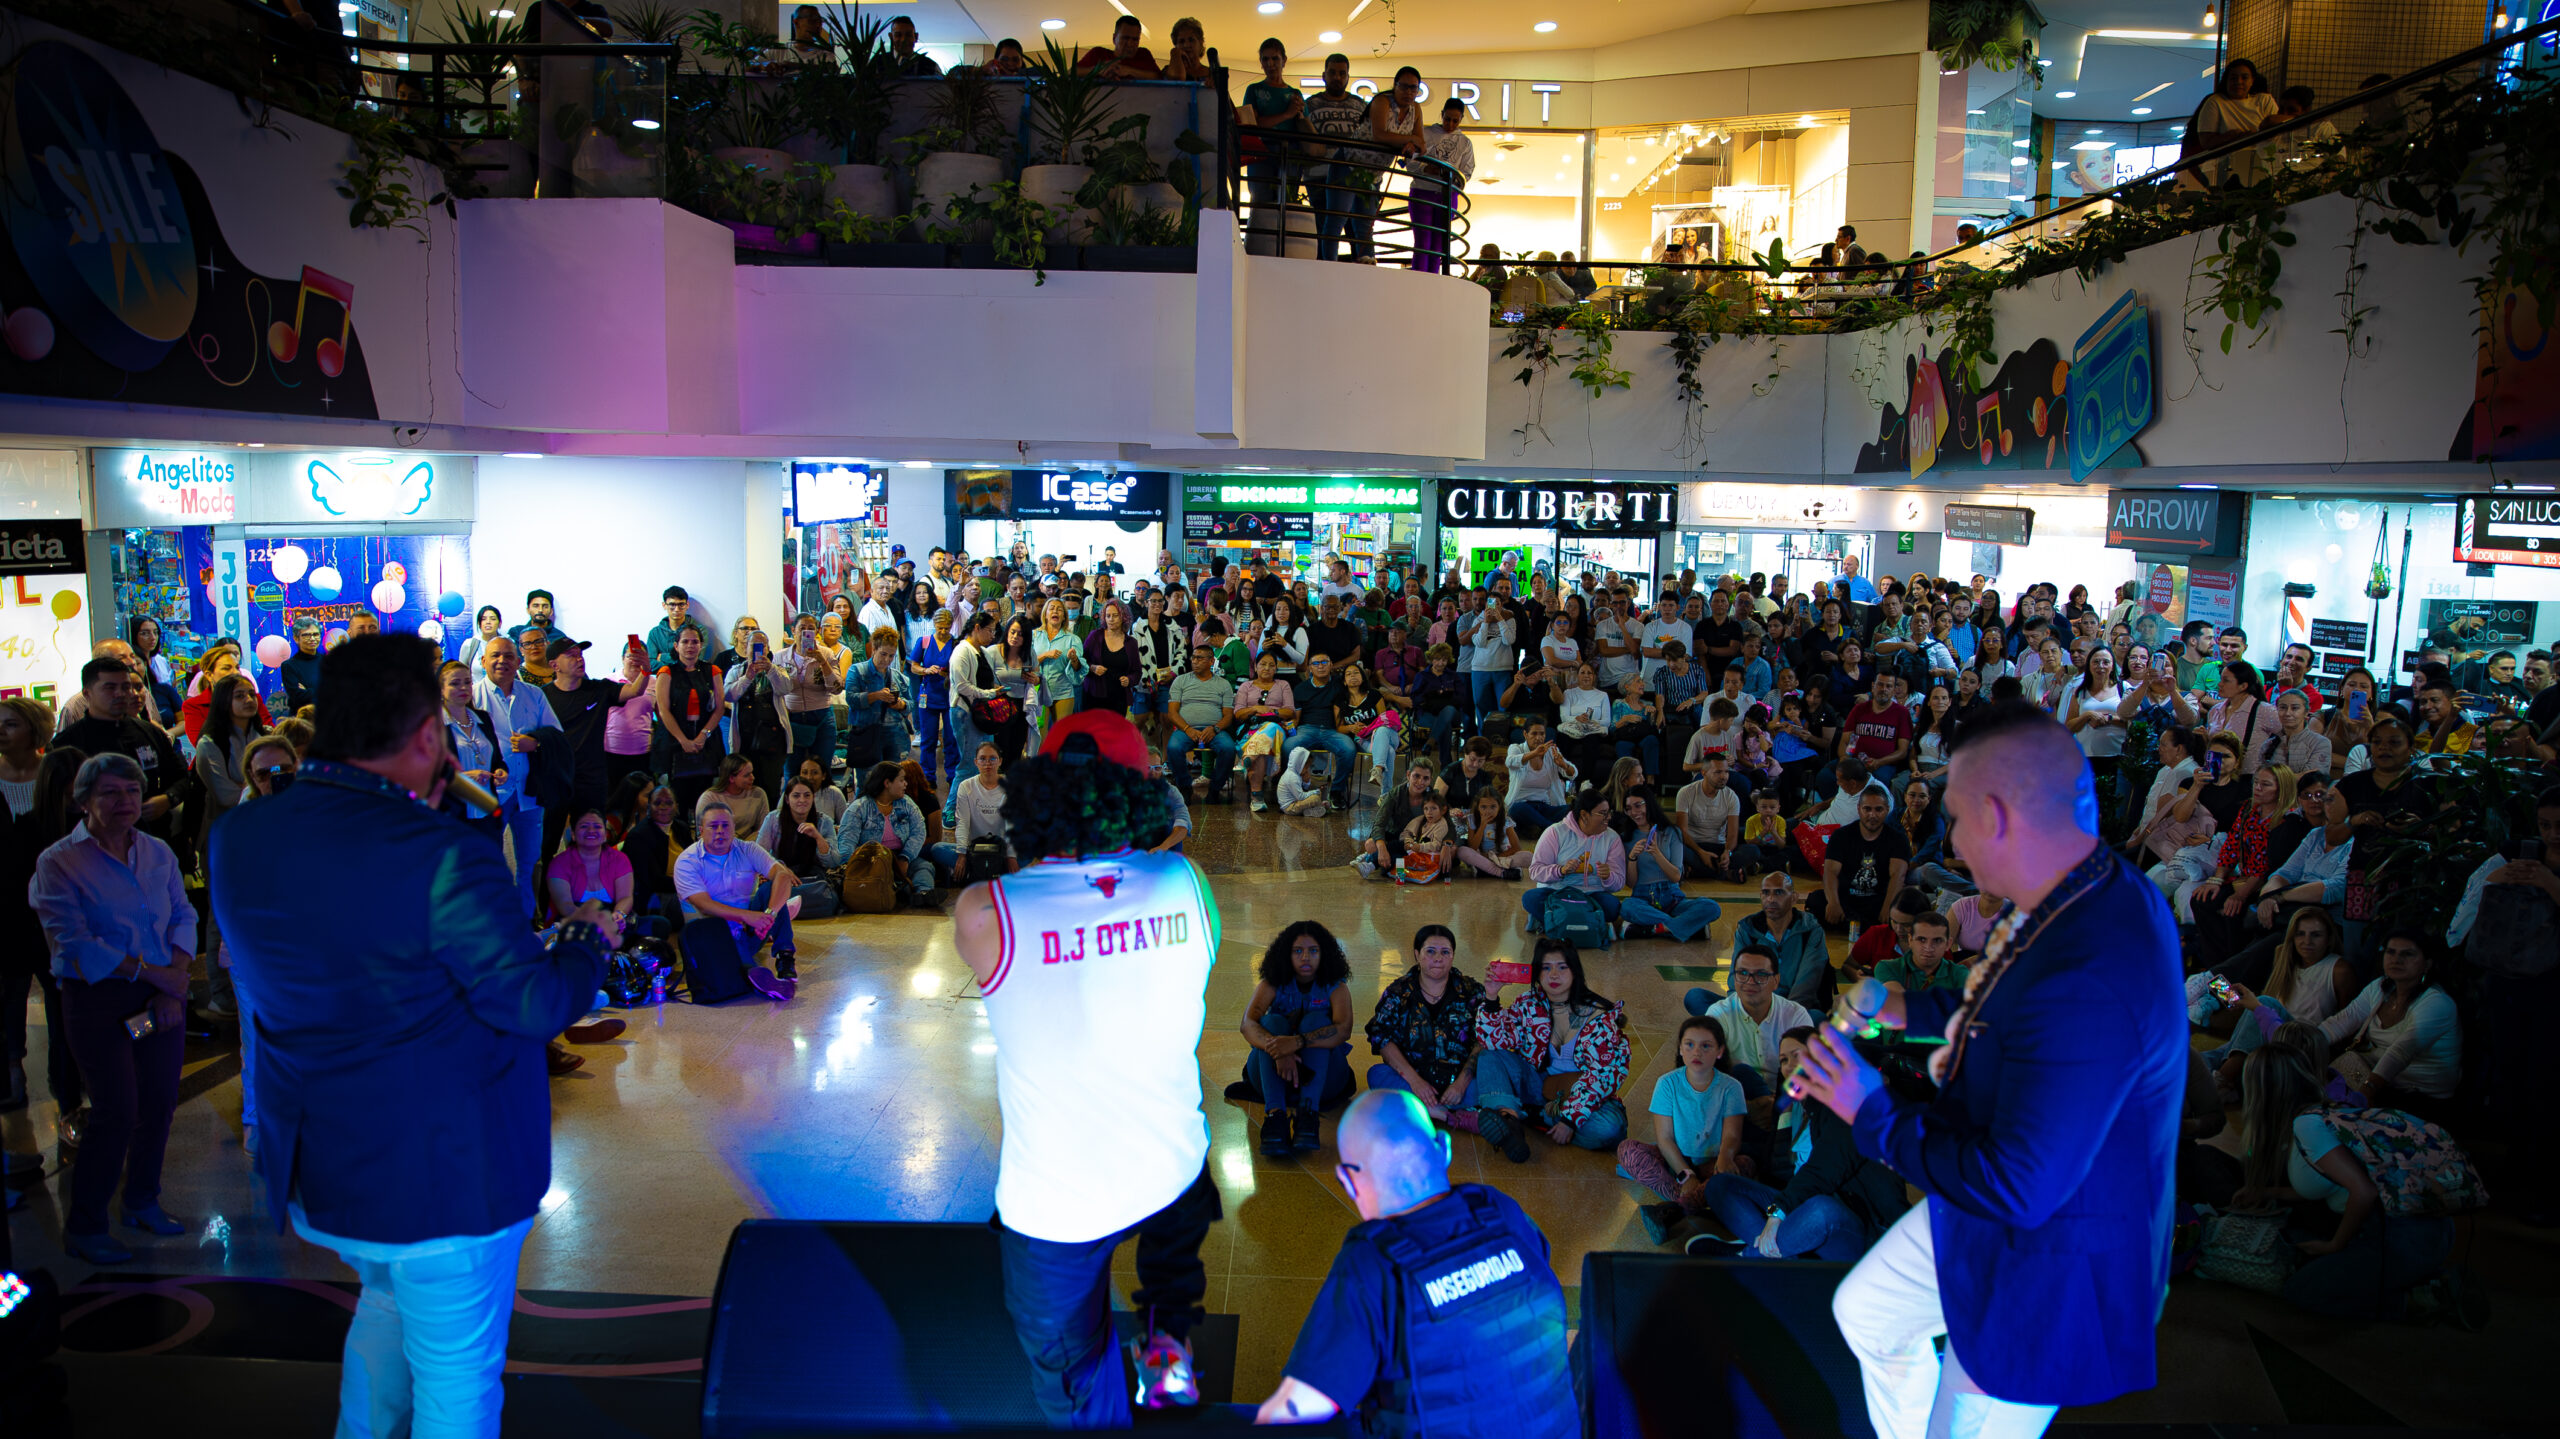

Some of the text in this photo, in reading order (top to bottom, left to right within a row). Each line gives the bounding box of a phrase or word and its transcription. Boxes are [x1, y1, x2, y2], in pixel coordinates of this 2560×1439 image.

[2117, 163, 2132, 174] La
[44, 145, 181, 243] SALE
[138, 454, 235, 490] Angelitos
[181, 487, 235, 515] Moda
[1042, 474, 1129, 503] ICase
[1221, 486, 1307, 504] EDICIONES
[1314, 484, 1418, 505] HISPÁNICAS
[1448, 488, 1672, 523] CILIBERTI
[2113, 498, 2209, 531] ARROW
[2489, 500, 2525, 522] SAN
[1, 531, 66, 560] ieta
[1477, 549, 1525, 562] TOA
[2474, 551, 2495, 561] LOCAL
[2497, 552, 2513, 562] 1344
[2427, 582, 2461, 596] 1344
[1042, 912, 1188, 964] D.J OTAVIO
[1425, 1248, 1525, 1308] INSEGURIDAD
